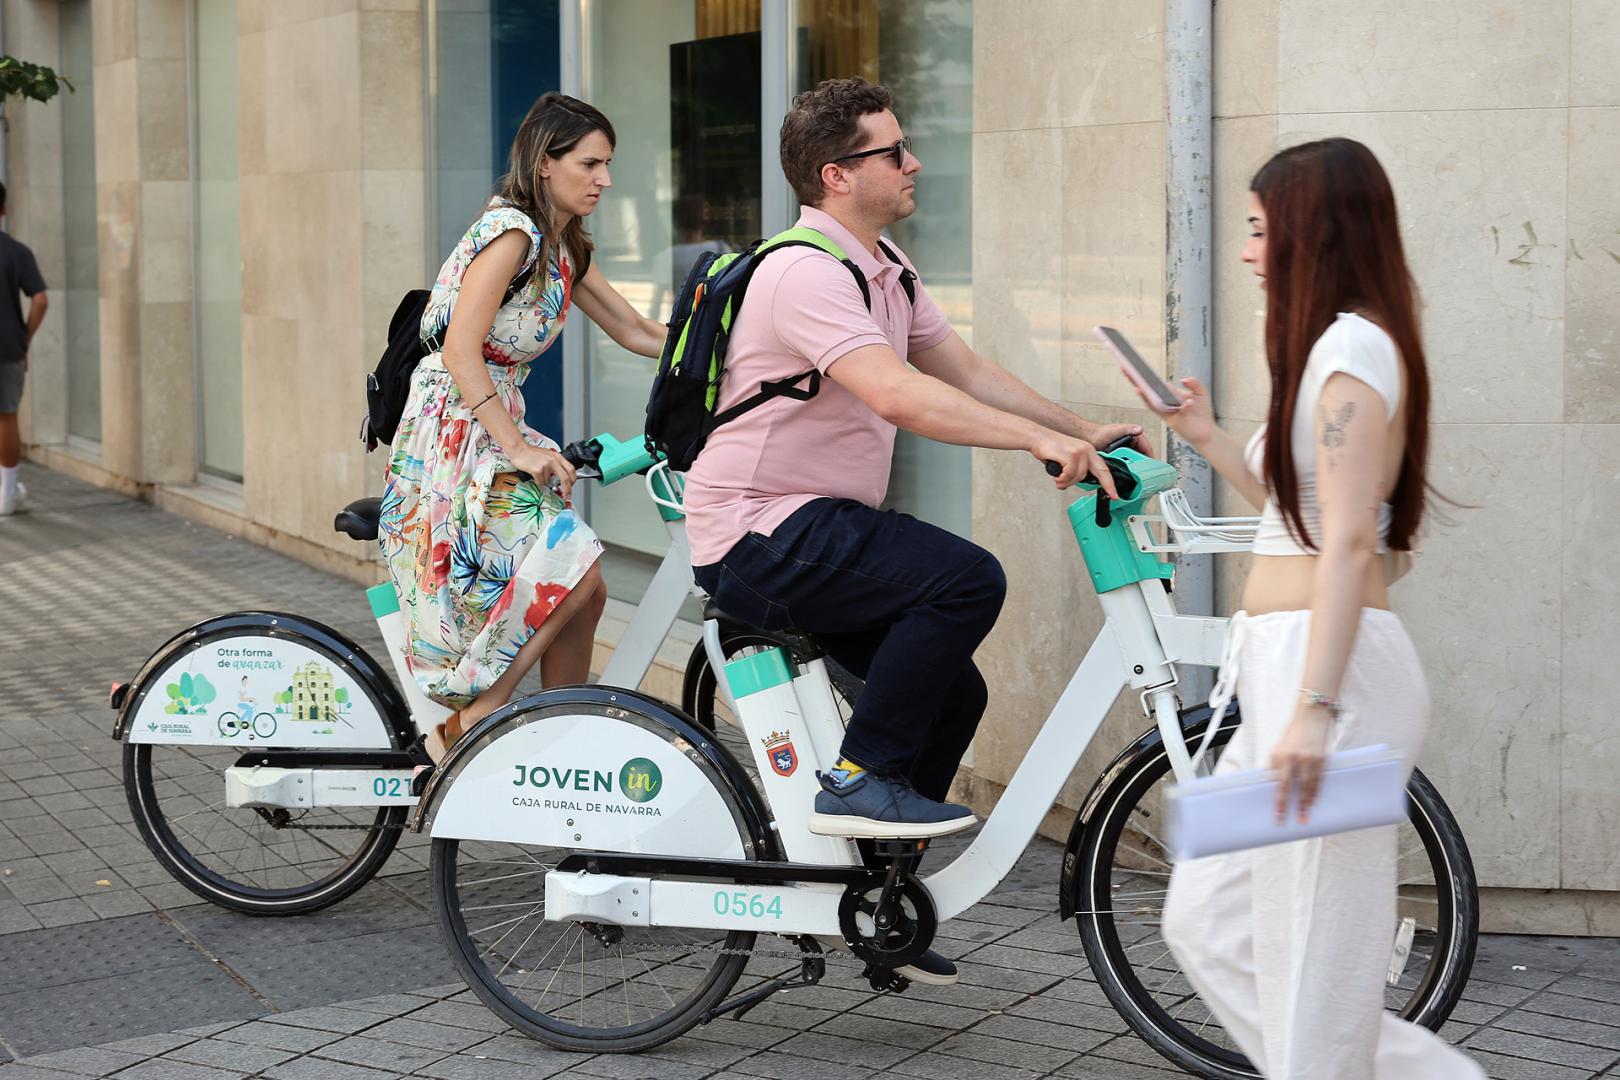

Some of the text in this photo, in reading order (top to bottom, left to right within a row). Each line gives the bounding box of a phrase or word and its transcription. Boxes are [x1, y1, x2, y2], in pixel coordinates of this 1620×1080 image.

[217, 648, 273, 657] Otra forma
[217, 659, 285, 671] de avanzar
[512, 764, 613, 793] JOVEN
[512, 797, 662, 817] CAJA RURAL DE NAVARRA
[713, 891, 783, 920] 0564
